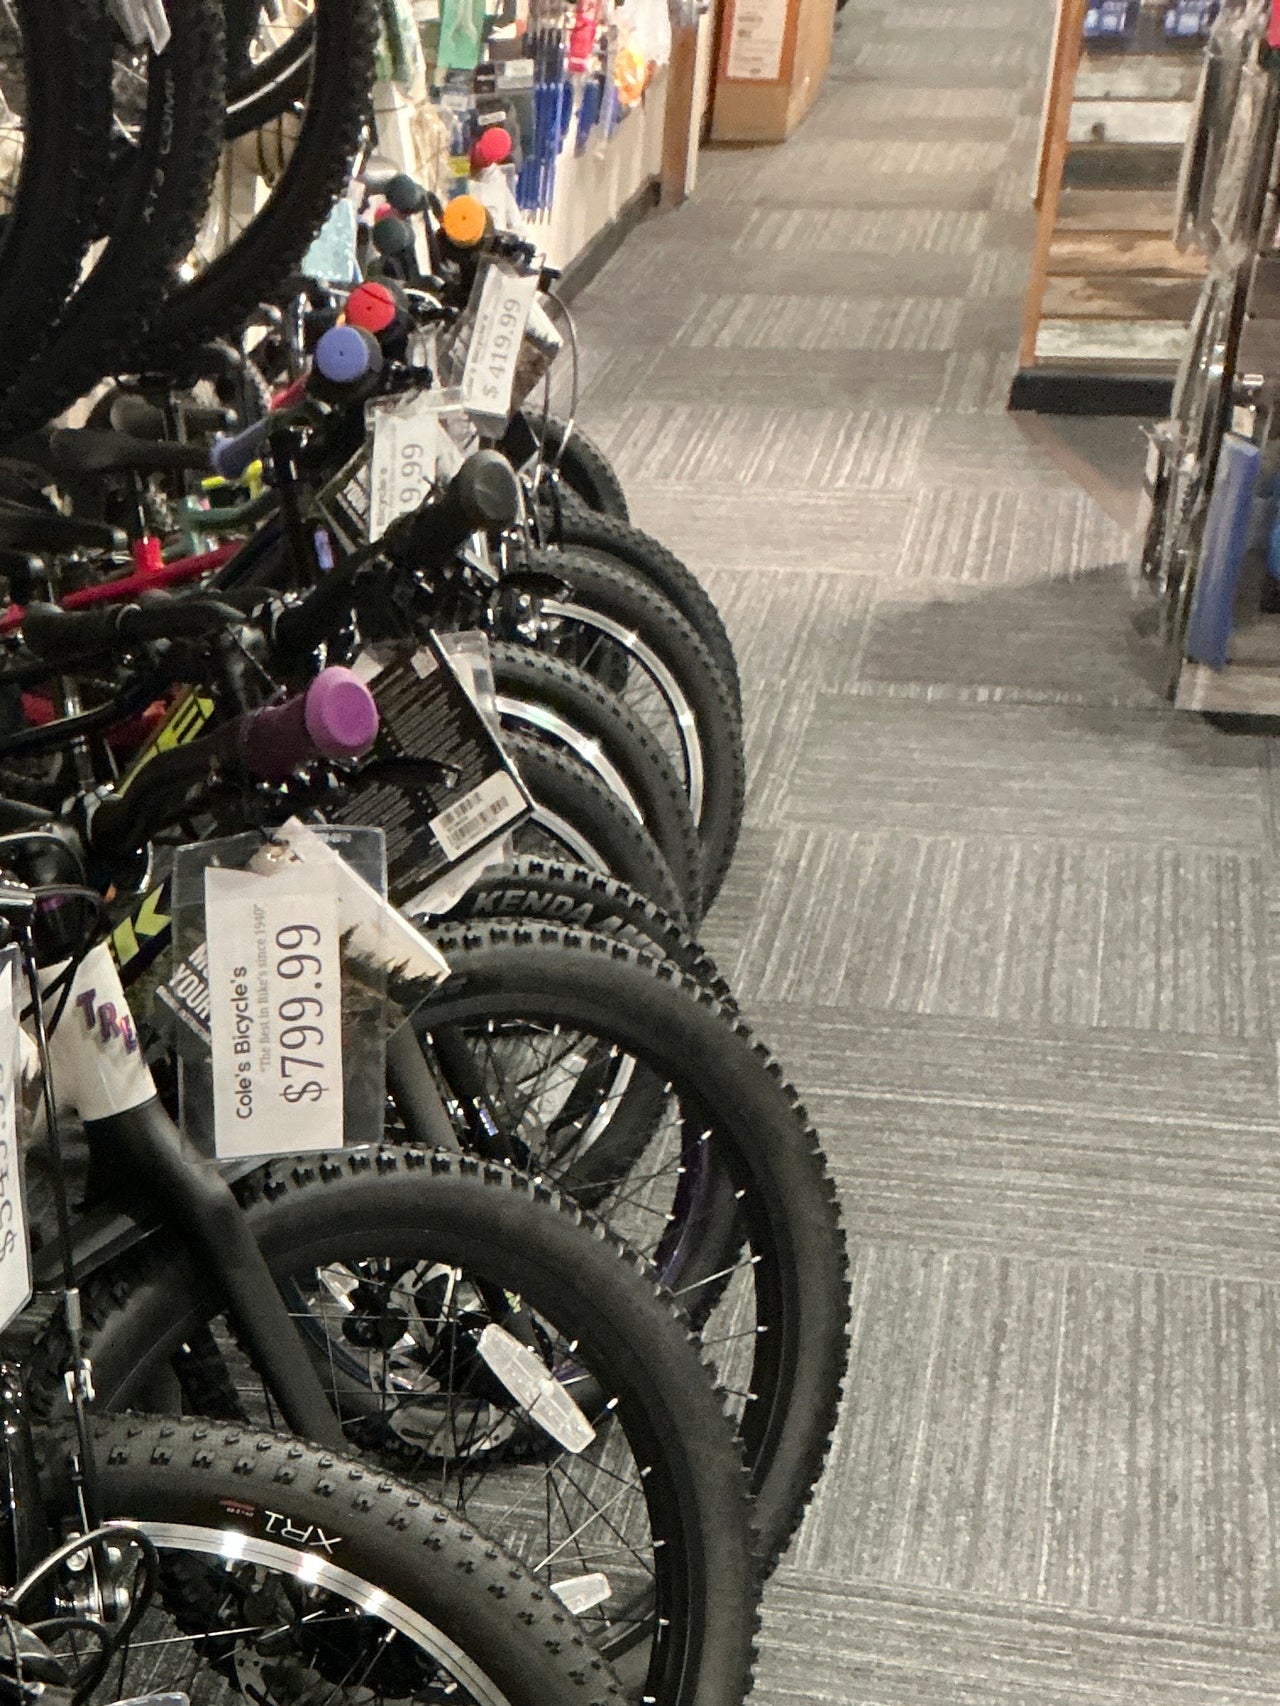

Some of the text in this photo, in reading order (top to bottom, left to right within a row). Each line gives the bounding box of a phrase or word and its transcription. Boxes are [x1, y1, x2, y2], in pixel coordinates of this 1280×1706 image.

[399, 443, 424, 504] 9.99
[472, 889, 595, 926] KENDA
[256, 936, 268, 969] since
[75, 987, 140, 1058] TRE
[230, 965, 254, 1119] Cole's Bicycle's
[276, 924, 329, 1103] $799.99
[264, 1509, 343, 1554] XR1
